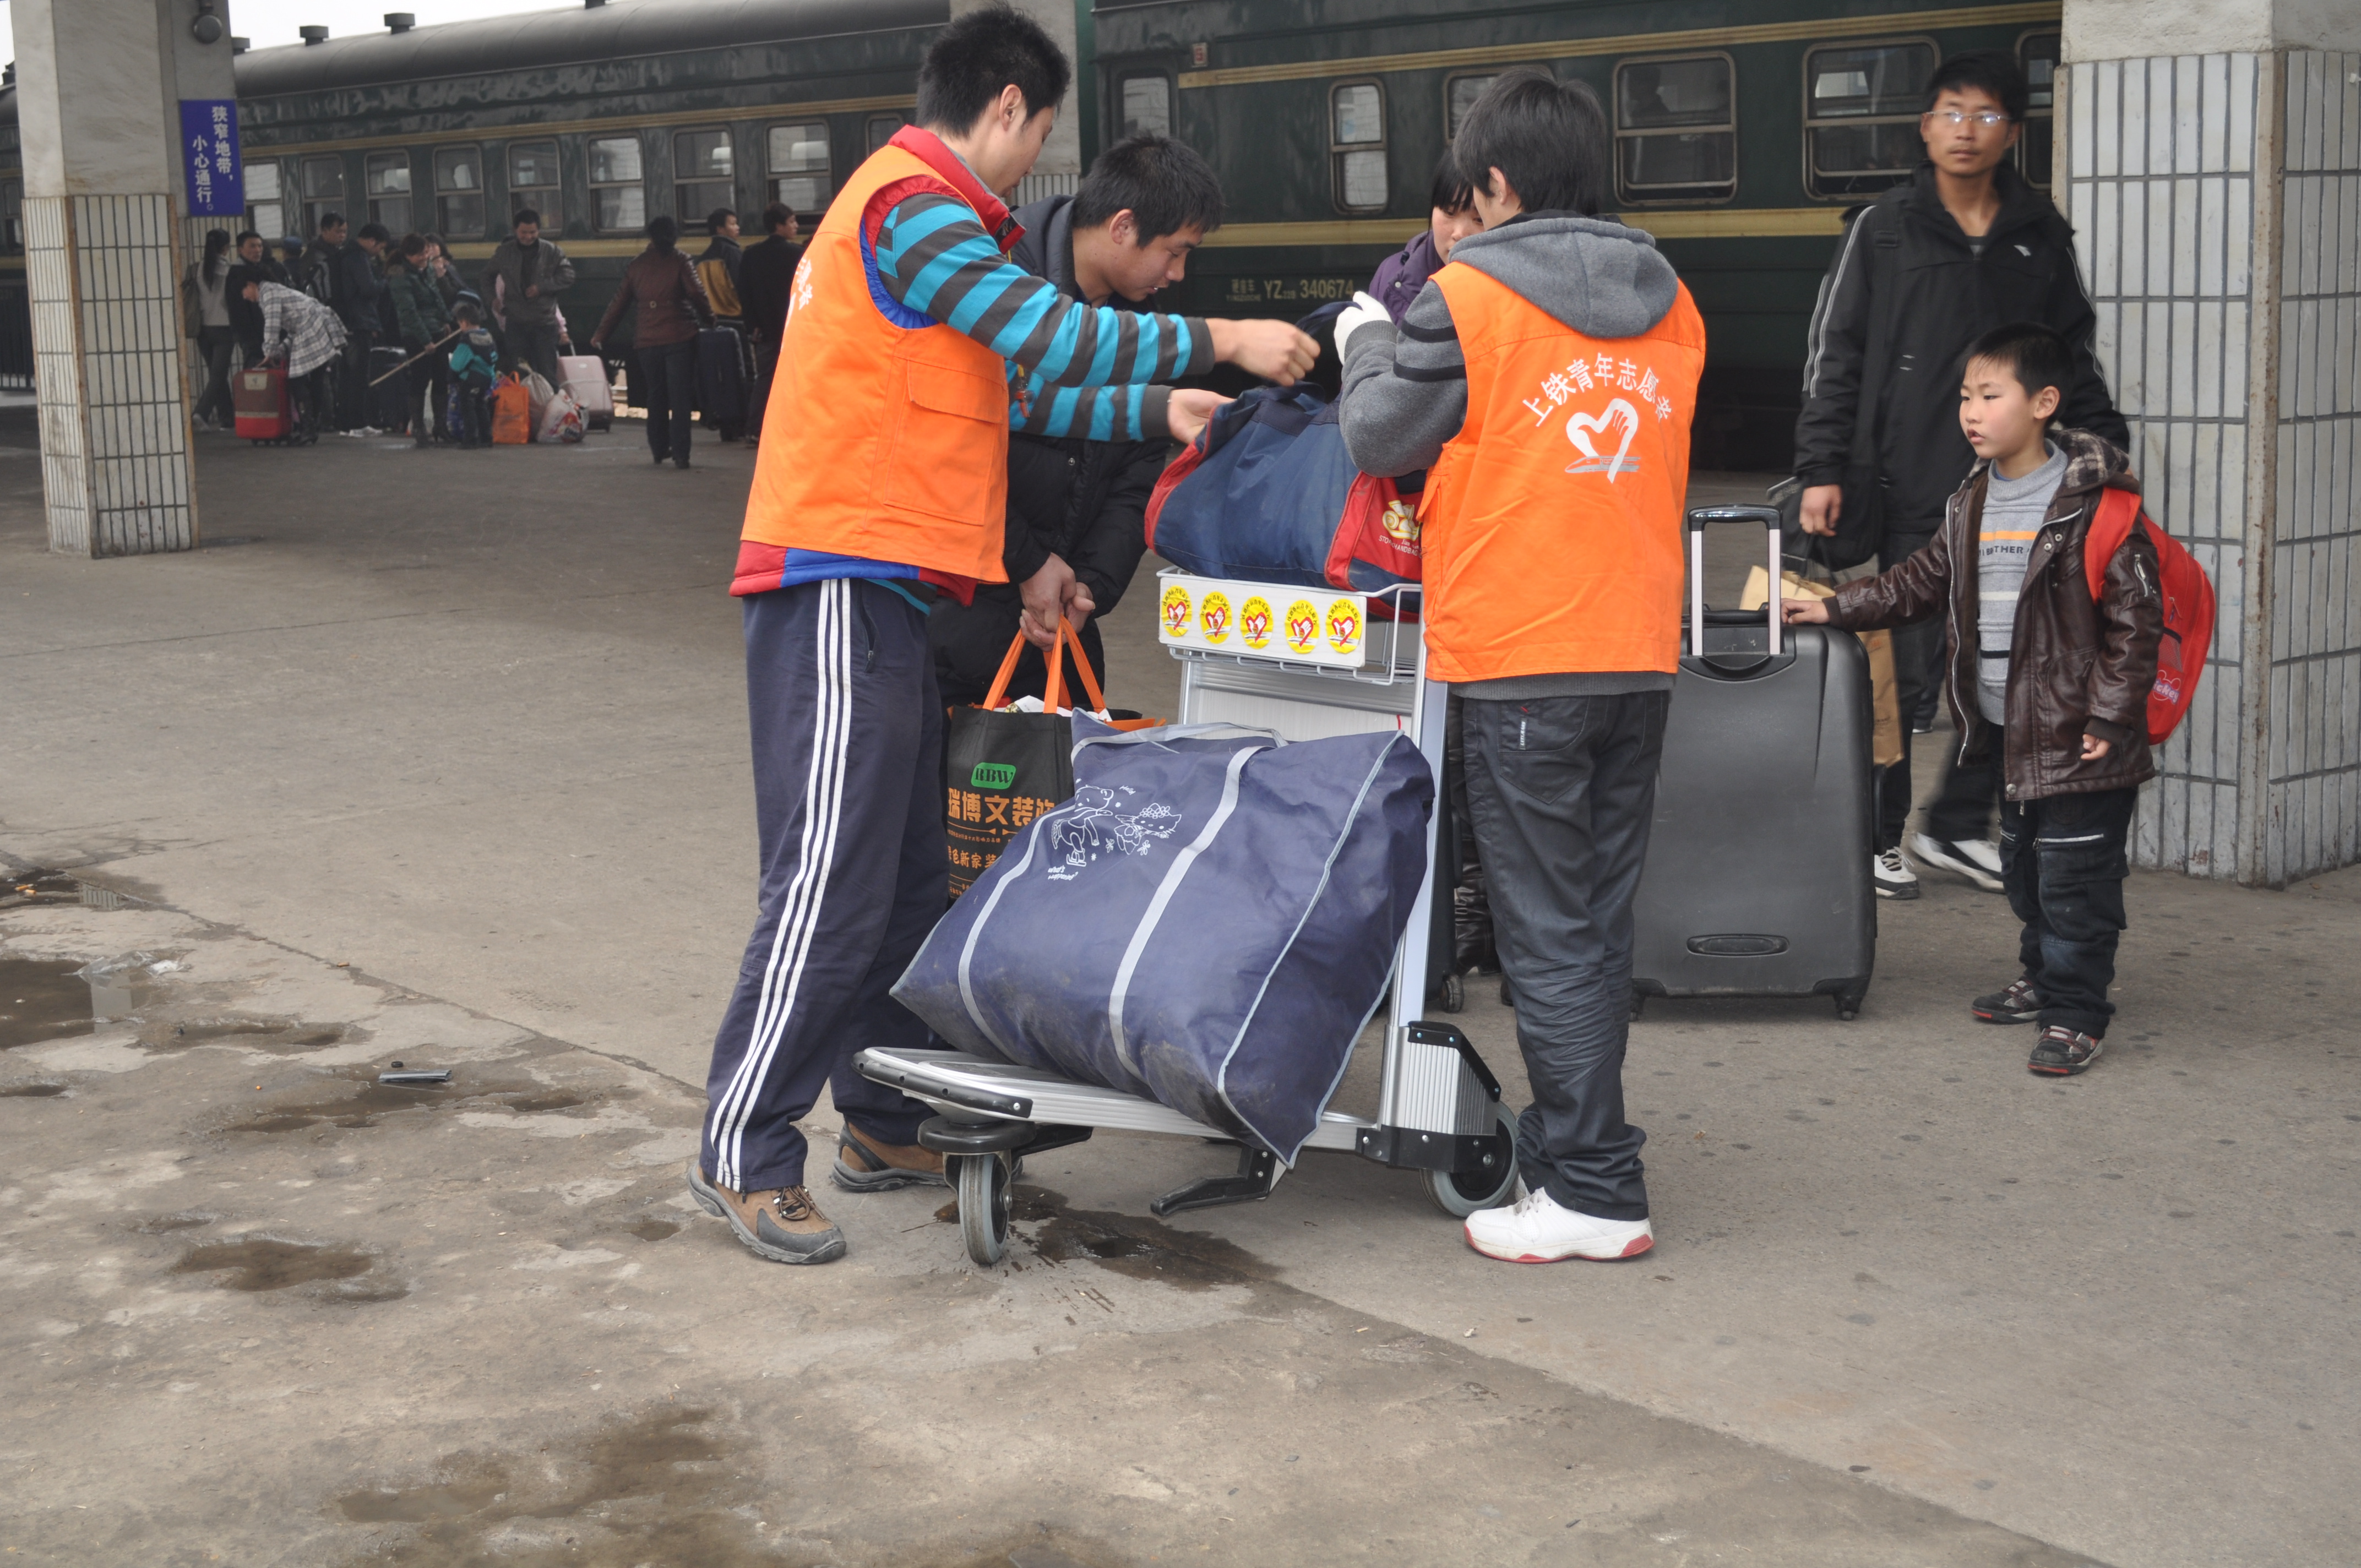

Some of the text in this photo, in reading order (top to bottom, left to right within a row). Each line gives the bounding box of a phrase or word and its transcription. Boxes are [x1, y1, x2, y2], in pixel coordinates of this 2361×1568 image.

[193, 135, 214, 211] 小心通行。
[1300, 279, 1354, 299] 340674
[1522, 352, 1672, 428] 上铁青年志愿者
[2153, 679, 2180, 704] ickey
[975, 767, 1014, 784] RBW
